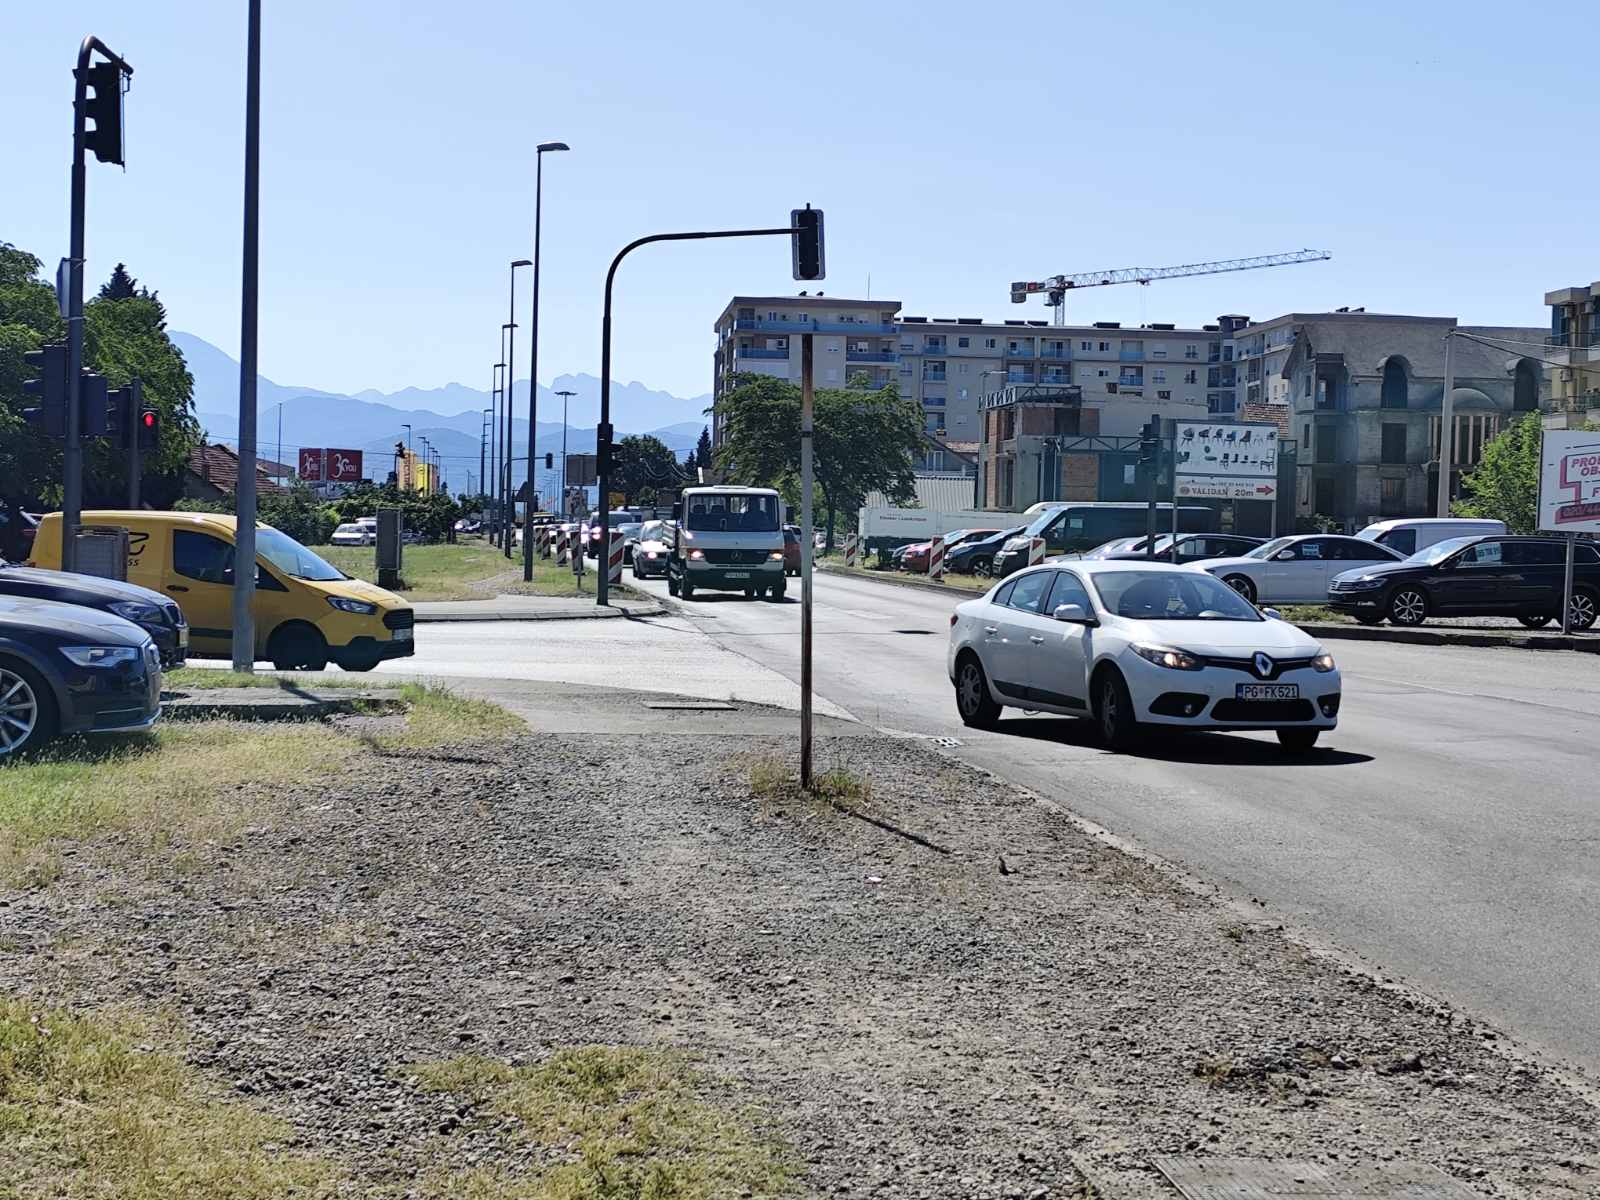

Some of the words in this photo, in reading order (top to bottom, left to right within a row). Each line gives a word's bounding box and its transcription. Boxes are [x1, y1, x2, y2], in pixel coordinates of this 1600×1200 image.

[1235, 489, 1254, 497] 20m
[1244, 686, 1258, 698] PG
[1264, 686, 1297, 698] FK521
